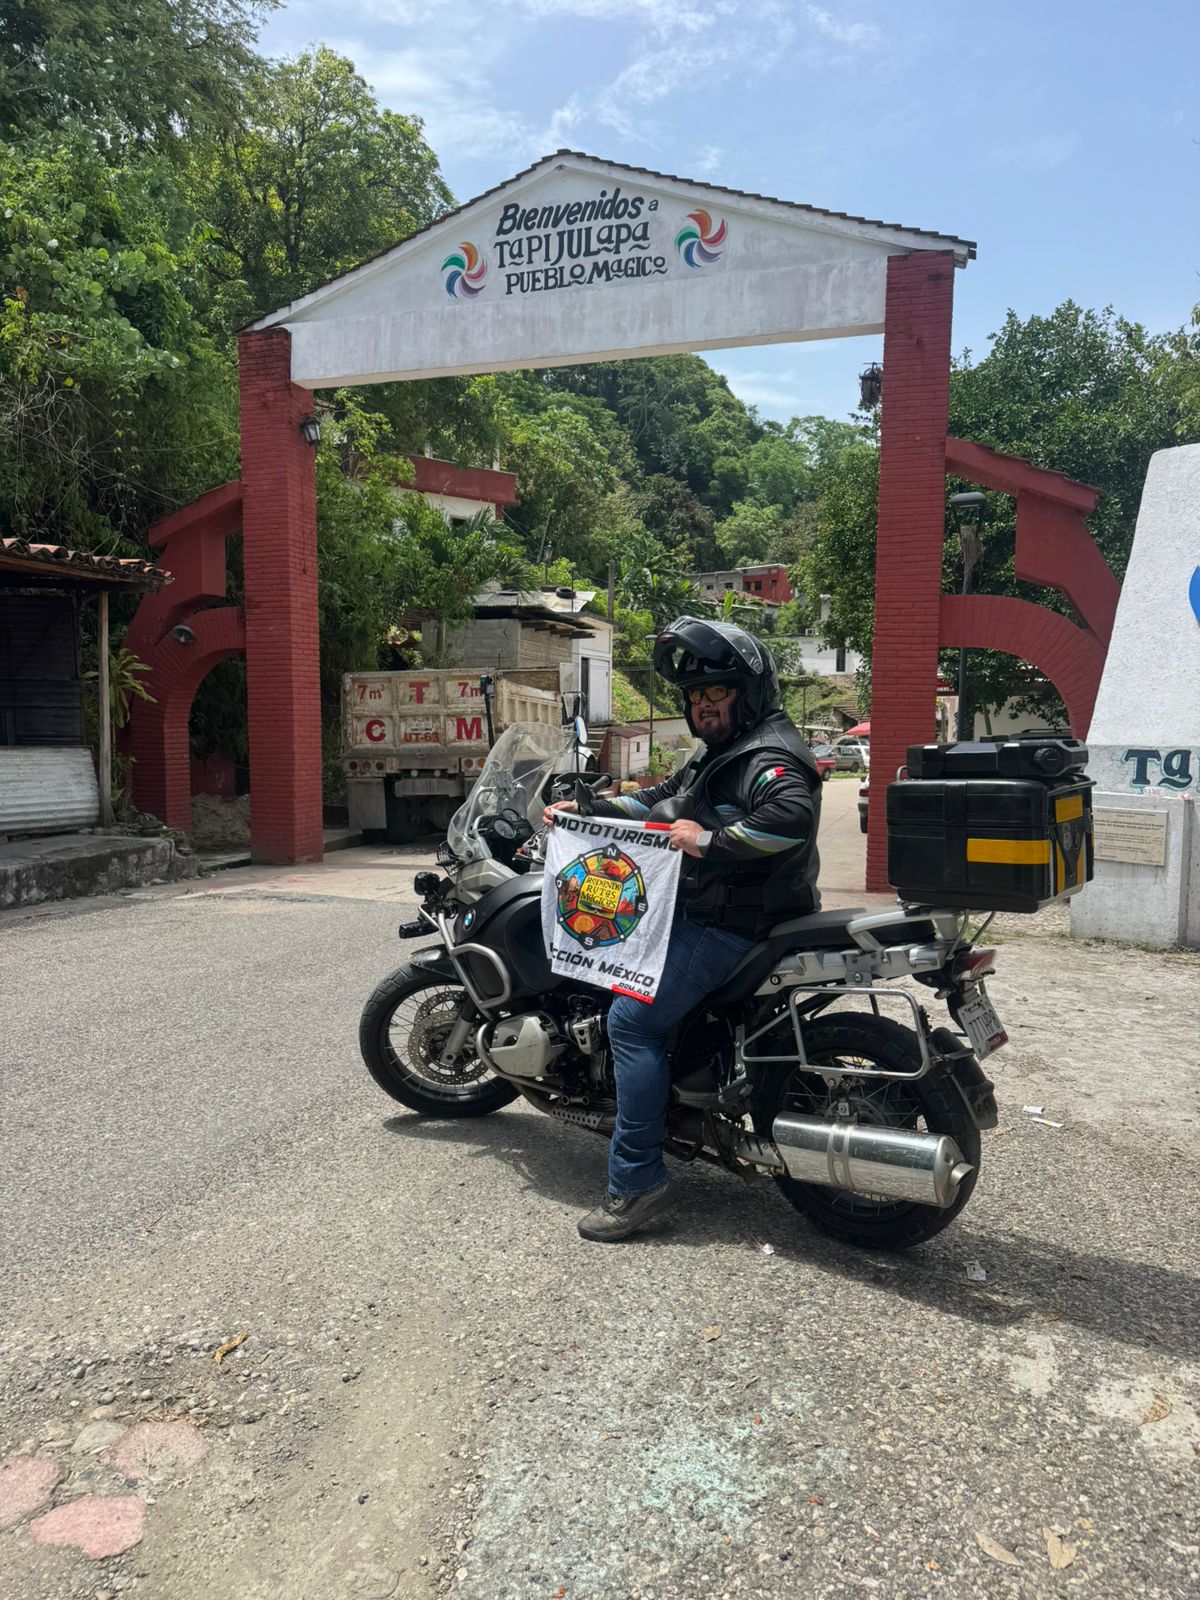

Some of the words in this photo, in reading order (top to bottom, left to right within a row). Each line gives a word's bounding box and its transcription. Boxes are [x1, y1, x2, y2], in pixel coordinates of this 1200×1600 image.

[496, 187, 644, 236] Bienvenidos
[648, 199, 659, 211] a
[409, 681, 430, 705] T
[365, 719, 386, 742] C
[455, 717, 482, 740] M
[607, 847, 616, 857] N
[637, 902, 647, 912] E
[584, 936, 594, 946] S
[598, 961, 655, 988] MÉXICO
